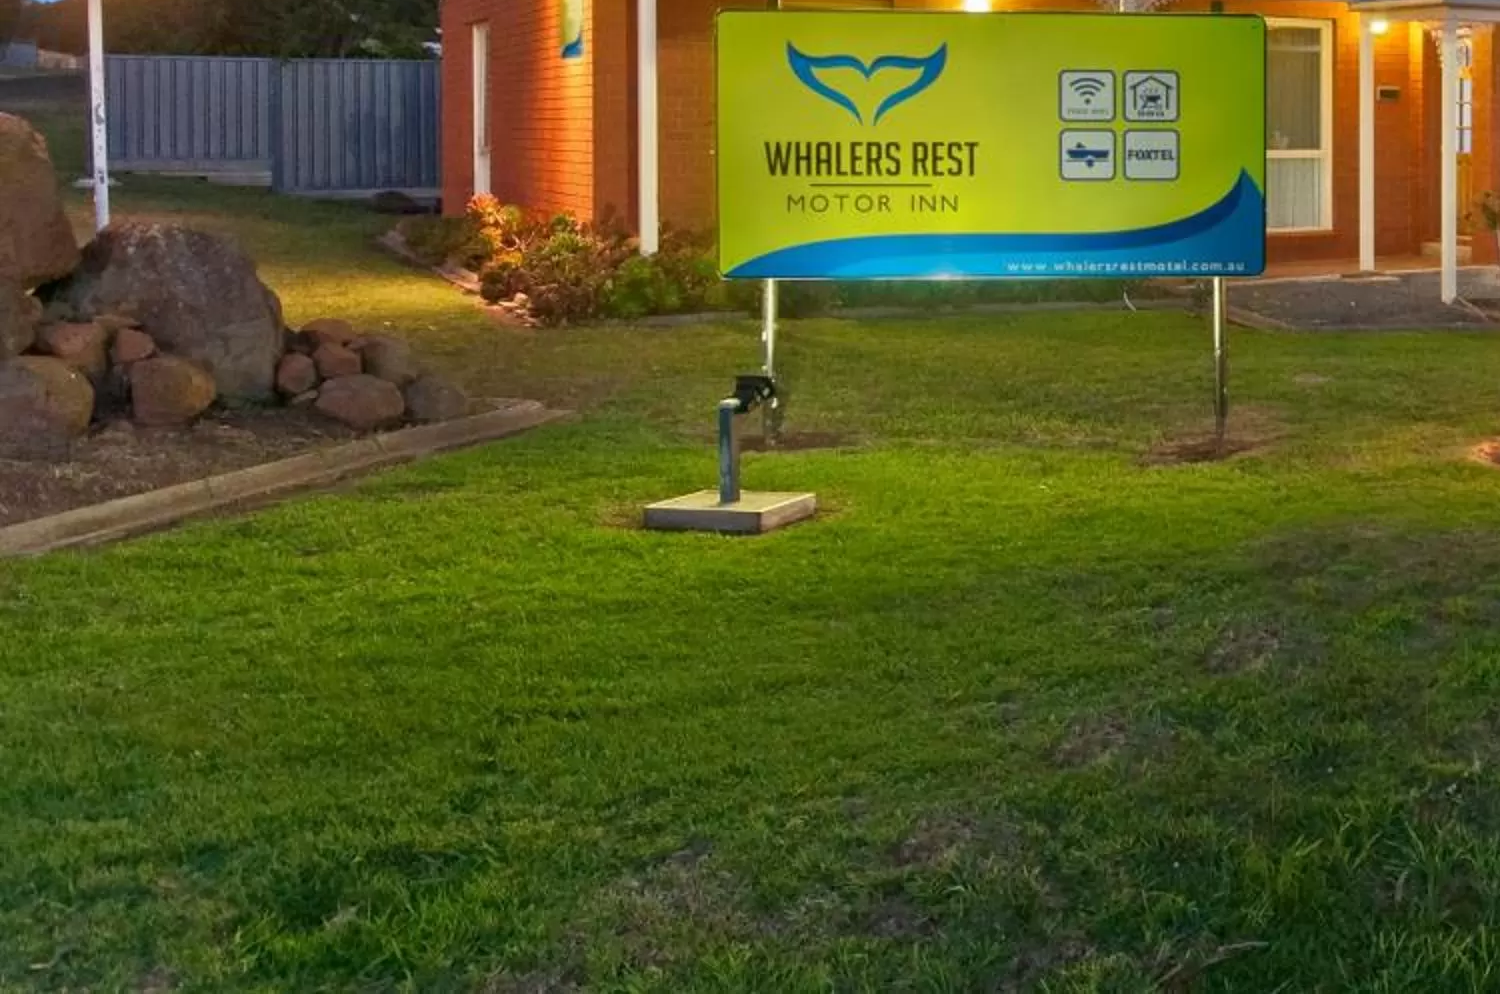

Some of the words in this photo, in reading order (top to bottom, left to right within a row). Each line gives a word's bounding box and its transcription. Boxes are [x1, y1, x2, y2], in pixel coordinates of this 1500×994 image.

[764, 141, 901, 177] WHALERS
[911, 141, 979, 177] REST
[1127, 149, 1175, 161] FOXTEL
[787, 193, 891, 214] MOTOR
[911, 194, 959, 213] INN
